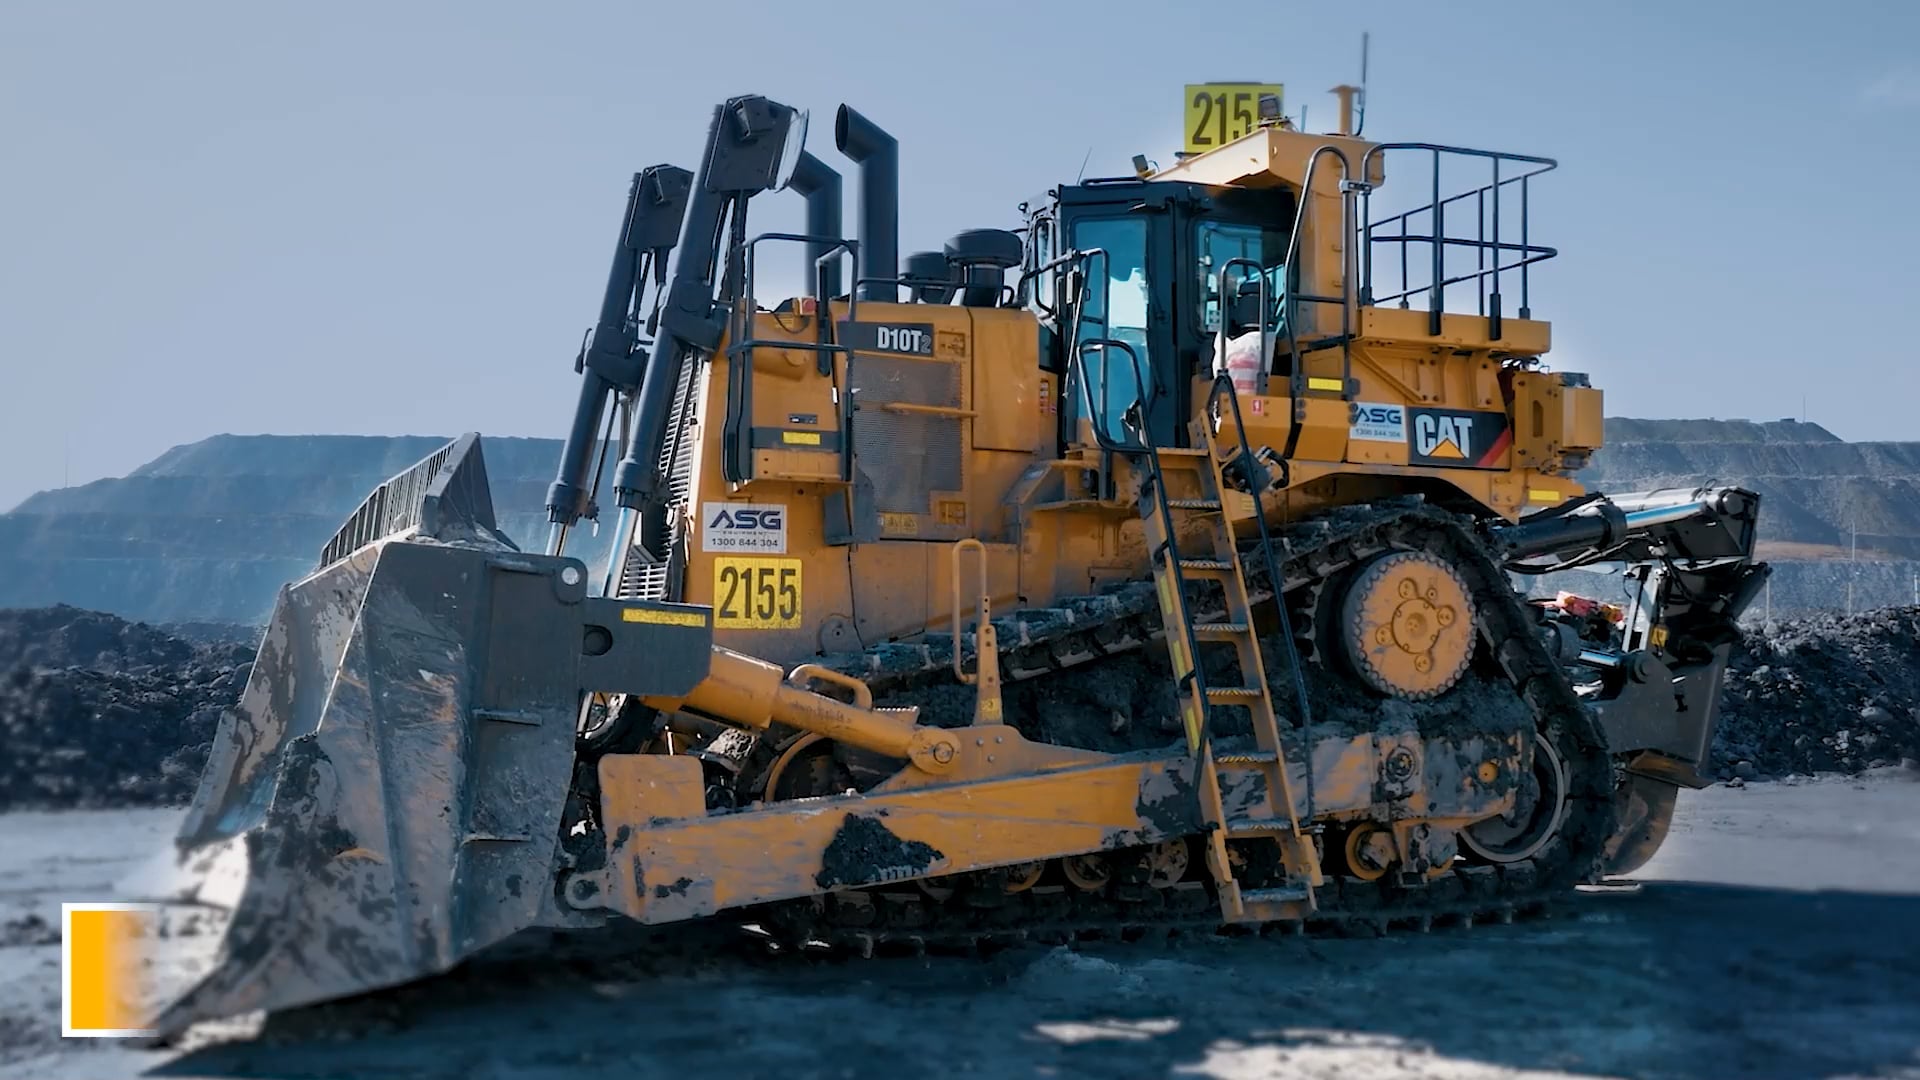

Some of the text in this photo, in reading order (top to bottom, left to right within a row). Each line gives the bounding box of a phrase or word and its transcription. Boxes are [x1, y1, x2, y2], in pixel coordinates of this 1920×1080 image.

[1192, 92, 1279, 145] 215
[1355, 407, 1402, 425] ASG
[1414, 413, 1473, 459] CAT
[709, 509, 782, 530] ASG
[712, 538, 779, 547] 1300 844 304
[719, 566, 797, 620] 2155
